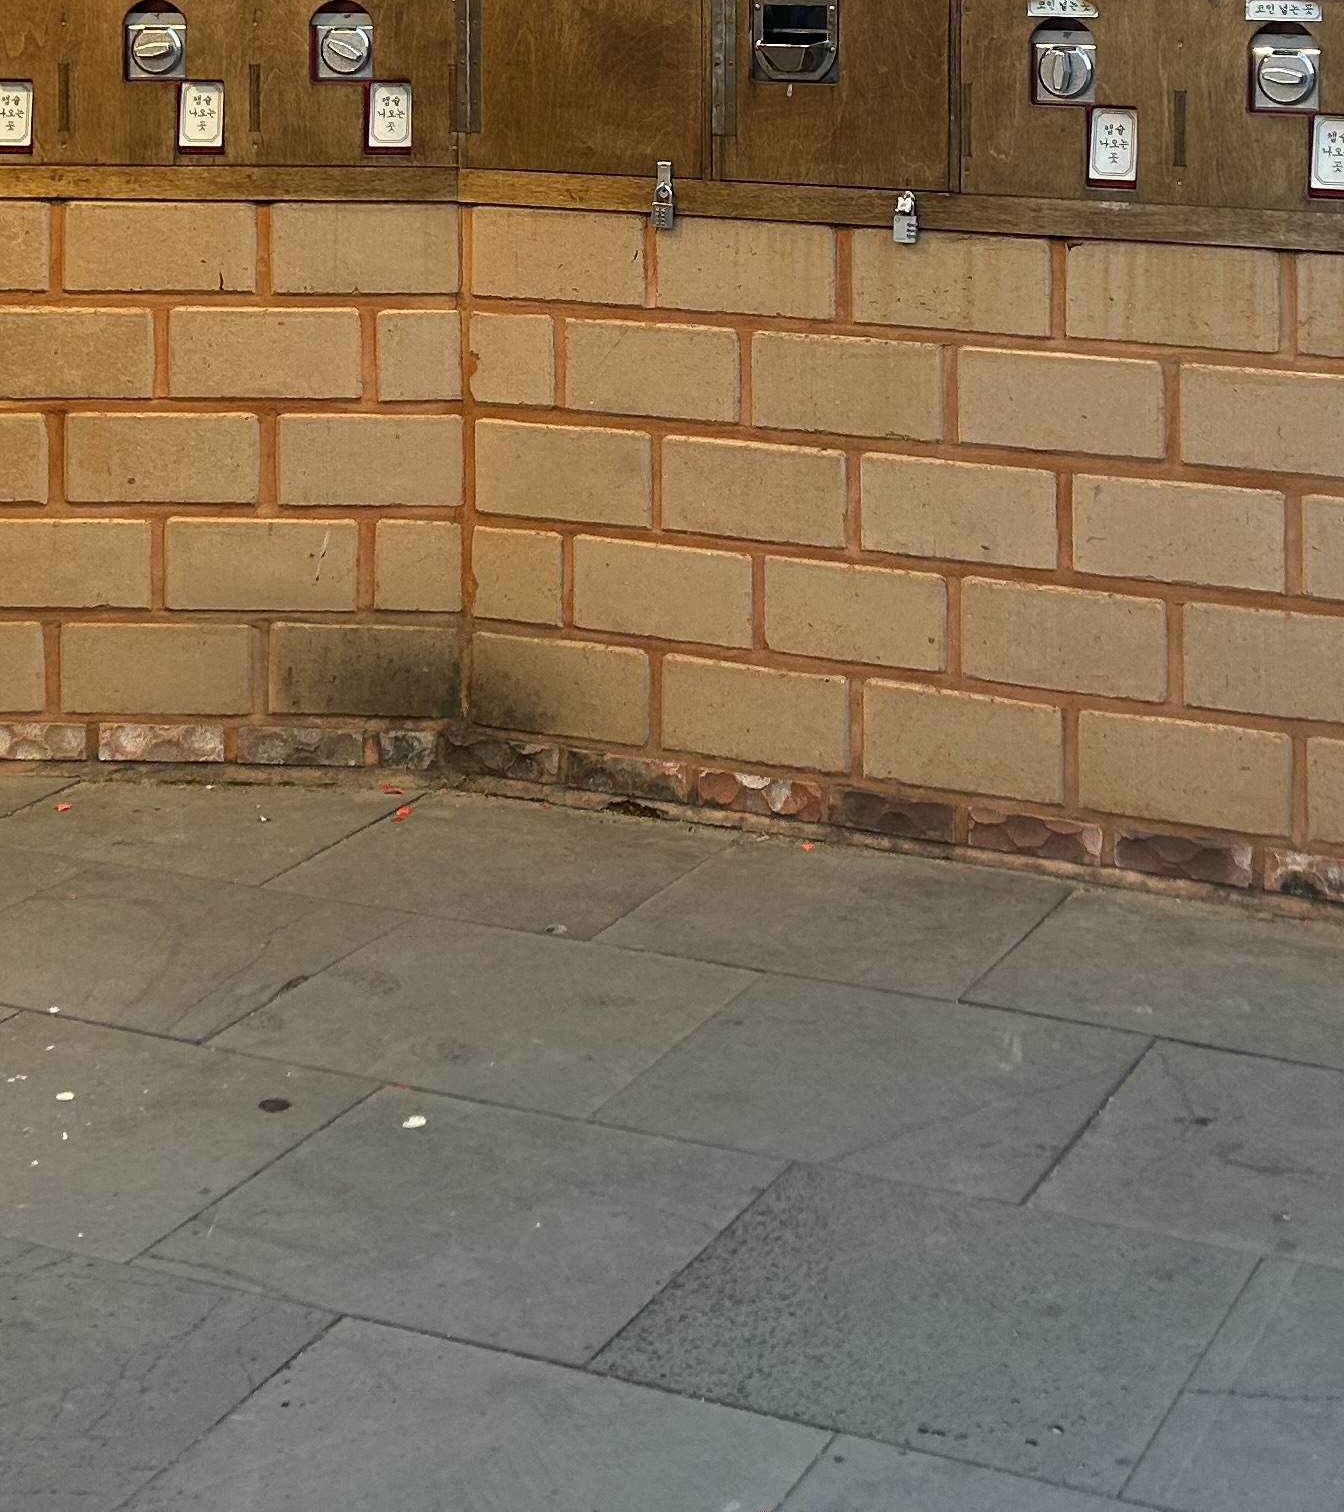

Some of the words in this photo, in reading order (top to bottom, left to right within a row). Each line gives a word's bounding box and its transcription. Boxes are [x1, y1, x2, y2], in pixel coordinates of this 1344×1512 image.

[1037, 0, 1055, 11] 코인
[1059, 0, 1078, 12] 넣는
[1081, 1, 1091, 12] 곳
[1255, 3, 1274, 15] 코인
[1279, 3, 1300, 16] 넣는
[1303, 4, 1314, 16] 곳
[2, 95, 21, 106] 캡슐
[193, 95, 212, 106] 캡슐
[382, 96, 401, 107] 캡슐
[189, 108, 216, 119] 나오는
[377, 108, 406, 119] 나오는
[5, 121, 15, 131] 곳
[197, 121, 207, 131] 곳
[386, 121, 396, 133] 곳
[1104, 124, 1126, 136] 캡슐
[1099, 138, 1129, 150] 나오는
[1107, 152, 1119, 164] 곳
[1333, 160, 1344, 173] 곳
